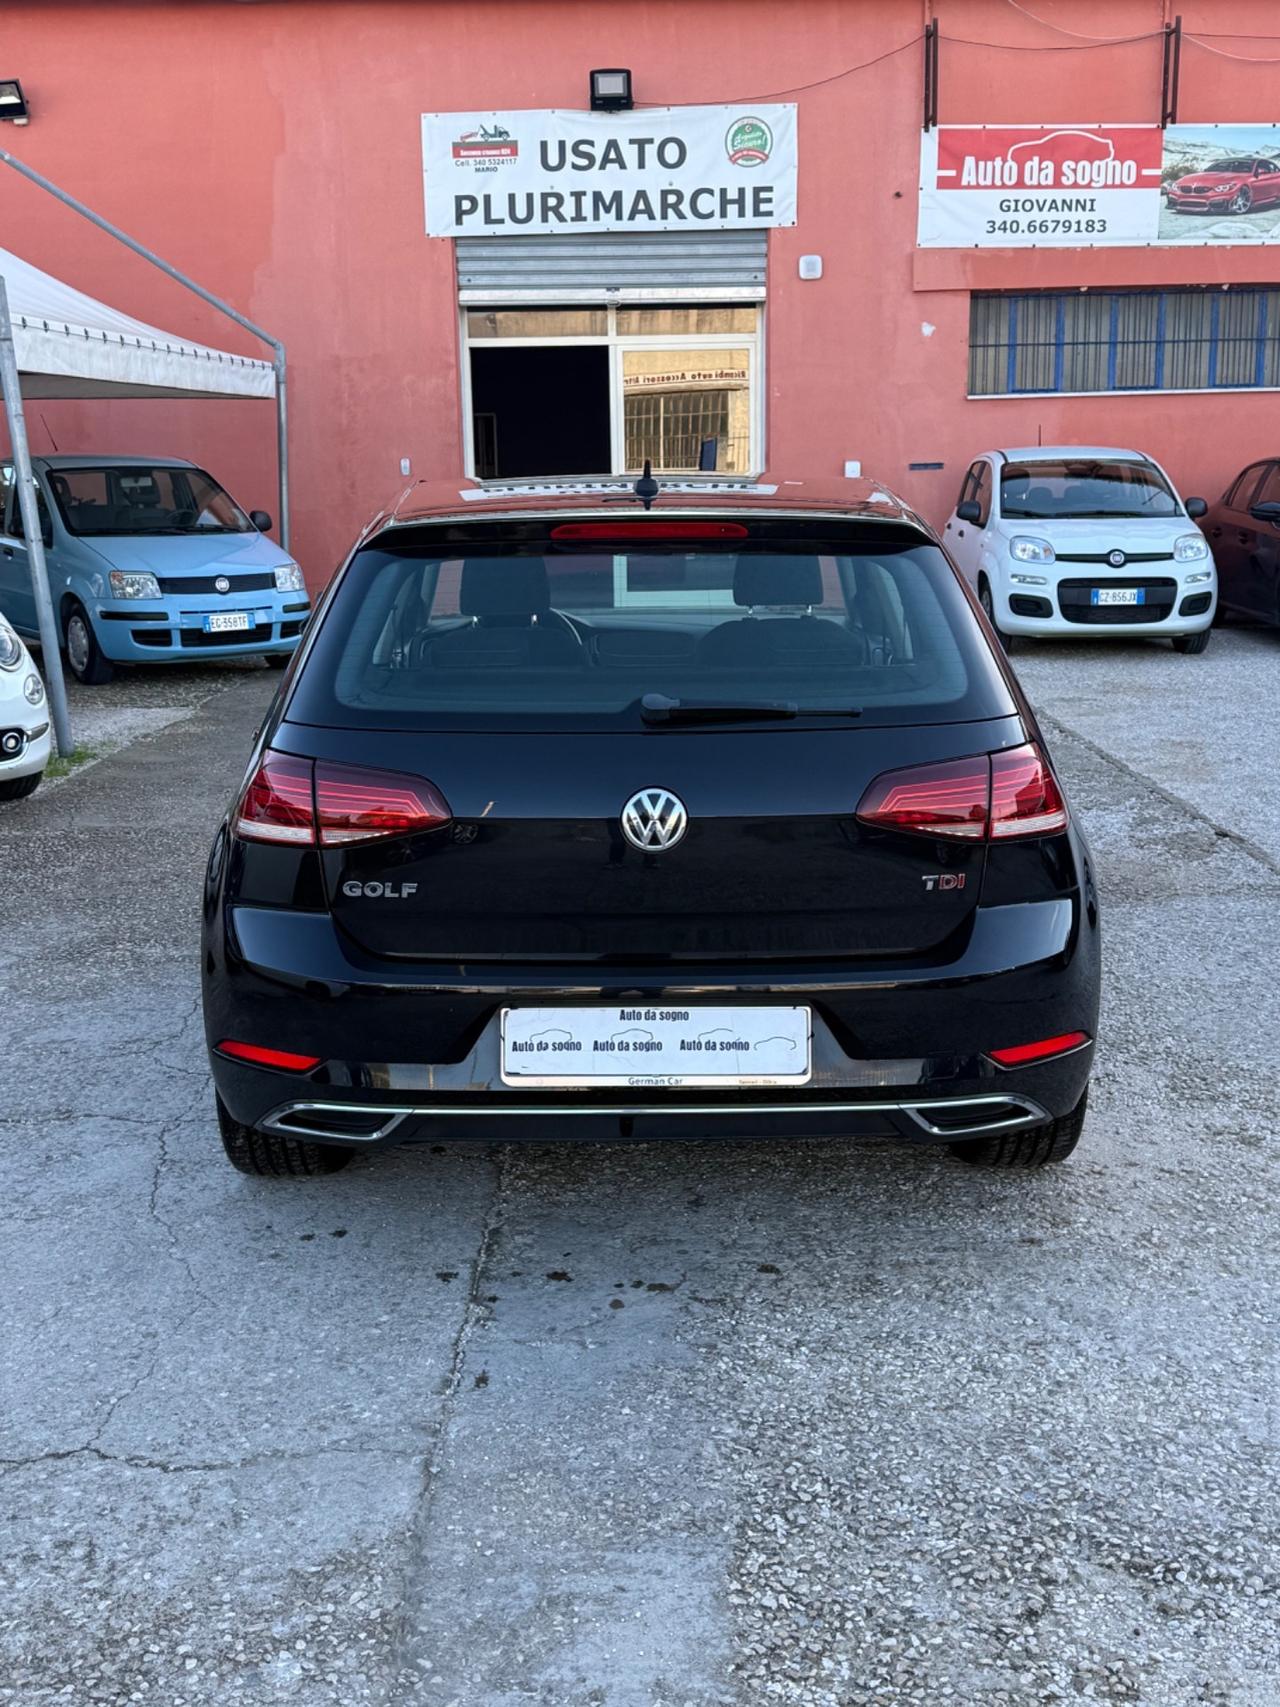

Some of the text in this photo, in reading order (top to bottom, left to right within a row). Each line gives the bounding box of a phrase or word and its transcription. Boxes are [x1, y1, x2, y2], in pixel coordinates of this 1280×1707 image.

[539, 137, 688, 172] USATO
[961, 156, 1138, 188] Auto da sogno
[454, 185, 775, 226] PLURIMARCHE
[999, 198, 1097, 214] GIOVANNI
[985, 219, 1107, 234] 340.6679183
[342, 880, 418, 898] GOLF
[922, 873, 966, 891] TDI
[619, 1009, 689, 1022] Auto da sogno
[512, 1041, 535, 1052] Auto
[537, 1041, 549, 1052] da
[593, 1040, 663, 1053] Auto da sogno
[680, 1039, 701, 1051] Auto
[704, 1039, 717, 1051] da
[628, 1077, 683, 1086] German Car
